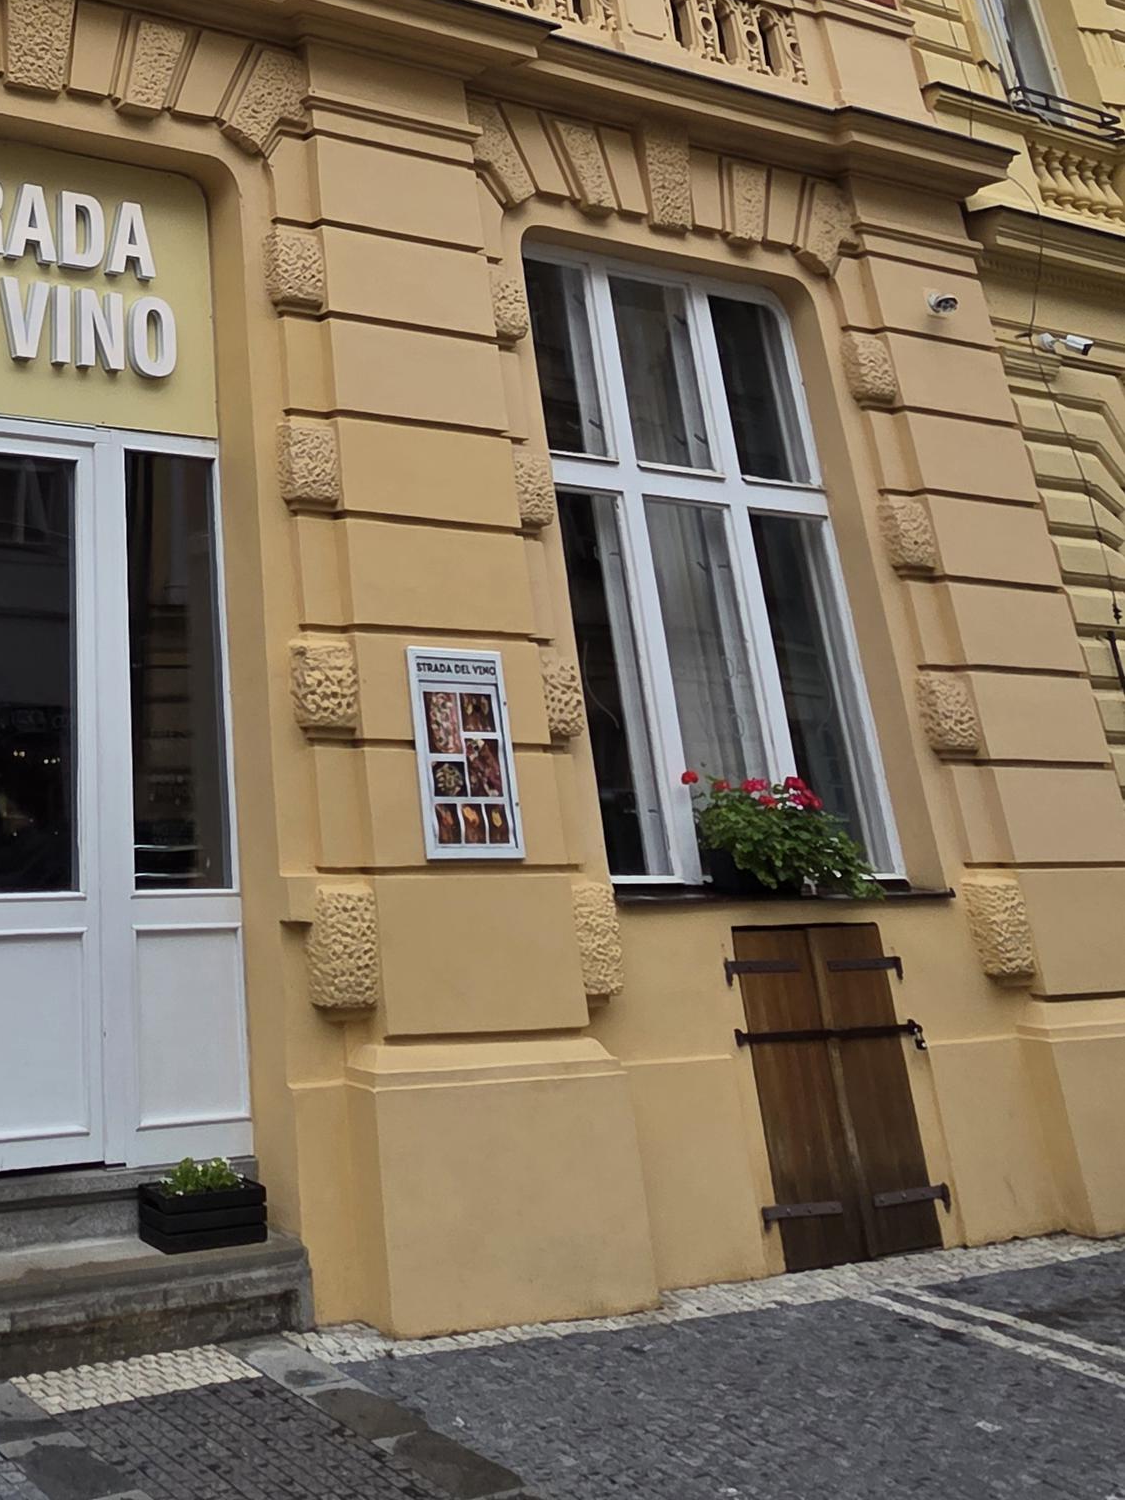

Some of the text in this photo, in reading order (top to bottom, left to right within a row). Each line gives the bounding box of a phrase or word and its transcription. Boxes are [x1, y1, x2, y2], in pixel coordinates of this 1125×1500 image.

[416, 662, 496, 676] STRADA DEL VINO
